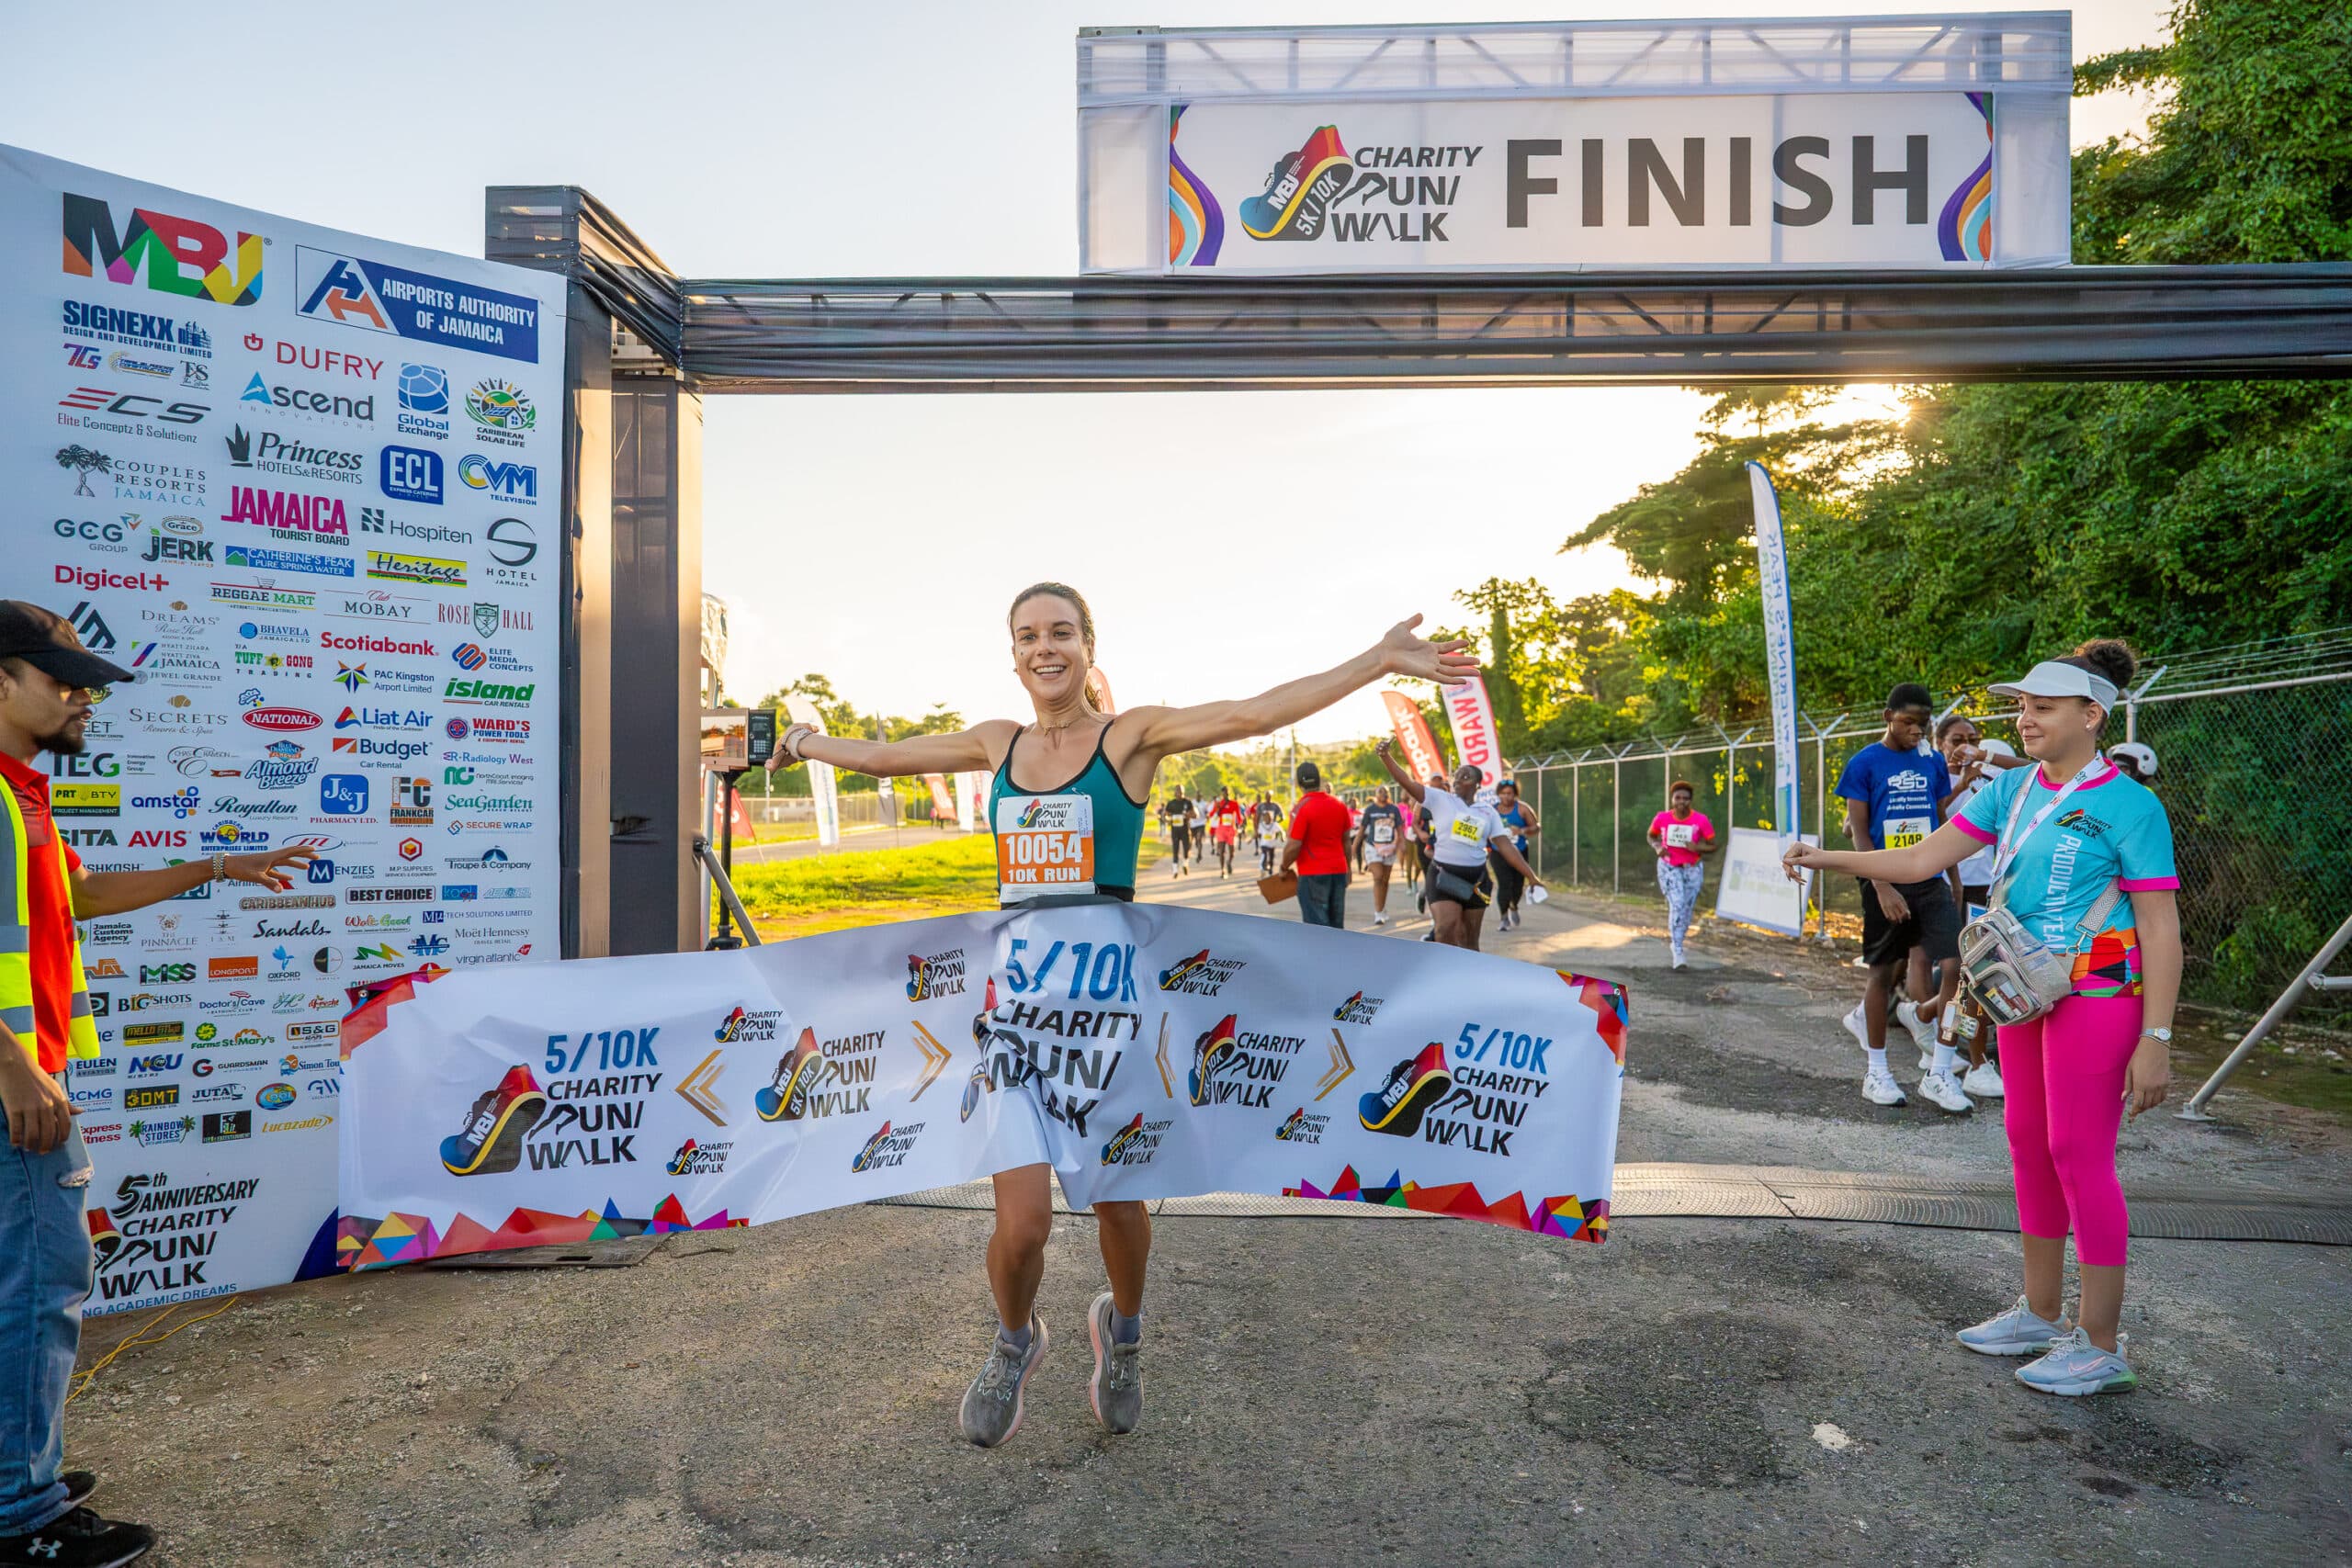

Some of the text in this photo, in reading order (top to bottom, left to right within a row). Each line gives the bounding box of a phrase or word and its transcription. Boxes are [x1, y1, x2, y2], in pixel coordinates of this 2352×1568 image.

[1354, 146, 1484, 168] CHARITY
[1507, 135, 1928, 228] FINISH
[1331, 212, 1449, 242] WALK
[62, 191, 263, 307] MBJ
[382, 278, 535, 328] AIRPORTS AUTHORITY
[62, 299, 175, 343] SIGNEXX
[416, 310, 504, 345] OF JAMAICA
[62, 325, 212, 358] DESIGN AND DEVELOPMENT LIMITED
[277, 341, 384, 380] DUFRY
[58, 412, 80, 427] Elite
[398, 413, 449, 431] Global
[398, 423, 449, 440] Exchange
[477, 426, 524, 440] CARIBBEAN
[476, 434, 526, 448] SOLAR LIFE
[258, 432, 363, 470] Princess
[114, 459, 206, 481] COUPLES
[390, 450, 438, 491] ECL
[458, 454, 537, 498] CVM
[114, 473, 206, 494] RESORTS
[114, 487, 206, 507] JAMAICA
[490, 494, 537, 505] TELEVISION
[220, 485, 348, 536] JAMAICA
[54, 519, 123, 542] GCG
[270, 528, 350, 547] TOURIST BOARD
[390, 520, 472, 544] Hospiten
[89, 544, 129, 553] GROUP
[249, 547, 352, 568] CATHERINE'S PEAK
[255, 558, 345, 575] PURE SPRING WATER
[377, 554, 460, 582] Heritage
[486, 568, 537, 581] HOTEL
[211, 587, 315, 606] REGGAE MART
[345, 601, 412, 617] MOBAY
[438, 603, 534, 631] ROSE HALL
[142, 610, 216, 626] DREAMS
[260, 625, 310, 637] BHAVELA
[321, 631, 435, 656] Scotiabank
[490, 648, 513, 656] ELITE
[161, 658, 220, 670] JAMAICA
[235, 651, 313, 669] TUFF GONG
[490, 656, 517, 664] MEDIA
[490, 664, 534, 672] CONCEPTS
[184, 674, 221, 682] GRANDE
[236, 668, 311, 679] TRADING
[374, 671, 435, 682] PAC Kingston
[374, 682, 432, 694] Airport Limited
[443, 678, 536, 701] island
[130, 708, 228, 726] SECRETS
[252, 713, 315, 726] NATIONAL
[363, 707, 434, 727] Liat Air
[472, 718, 530, 732] WARD'S
[473, 729, 530, 739] POWER TOOLS
[360, 739, 428, 761] Budget
[244, 757, 319, 779] Almond
[360, 761, 374, 769] Car
[258, 773, 307, 790] Breeze
[131, 794, 201, 808] amstar
[209, 795, 299, 818] Royalton
[466, 821, 502, 829] SECURE
[1037, 819, 1065, 828] WALK
[2084, 814, 2113, 829] CHARITY
[128, 830, 187, 847] AVIS
[1006, 833, 1083, 865] 10054
[449, 861, 531, 871] Troupe Company
[1008, 866, 1080, 882] 10K RUN
[350, 888, 433, 901] BEST CHOICE
[466, 910, 503, 919] SOLUTIONS
[253, 919, 331, 938] Sandals
[483, 927, 529, 938] Hennessy
[141, 936, 198, 947] PINNACLE
[456, 952, 521, 965] virgin atlantic
[926, 949, 964, 964] CHARITY
[1206, 958, 1247, 971] CHARITY
[209, 967, 257, 976] LONGPORT
[268, 971, 300, 979] OXFORD
[1005, 939, 1138, 1002] 5/10K
[153, 993, 191, 1005] SHOTS
[746, 1010, 783, 1020] CHARITY
[990, 998, 1142, 1041] CHARITY
[546, 1027, 660, 1074] 5/10K
[822, 1031, 886, 1057] CHARITY
[1237, 1032, 1306, 1055] CHARITY
[1454, 1022, 1553, 1075] 5/10K
[76, 1058, 117, 1069] EULEN
[219, 1059, 268, 1069] GUARDSMAN
[299, 1061, 323, 1070] Simon
[547, 1073, 662, 1100] CHARITY
[1453, 1066, 1550, 1099] CHARITY
[1212, 1079, 1275, 1109] WALK
[809, 1087, 871, 1119] WALK
[141, 1120, 184, 1133] RAINBOW
[262, 1118, 322, 1134] Lucozade
[890, 1122, 925, 1136] CHARITY
[1141, 1120, 1173, 1132] CHARITY
[145, 1130, 180, 1141] STORES
[1425, 1117, 1514, 1157] WALK
[526, 1134, 638, 1171] WALK
[699, 1142, 734, 1151] CHARITY
[139, 1179, 259, 1213] ANNIVERSARY
[122, 1206, 237, 1237] CHARITY
[99, 1261, 207, 1300] WALK
[106, 1283, 236, 1314] ACADEMIC DREAMS
